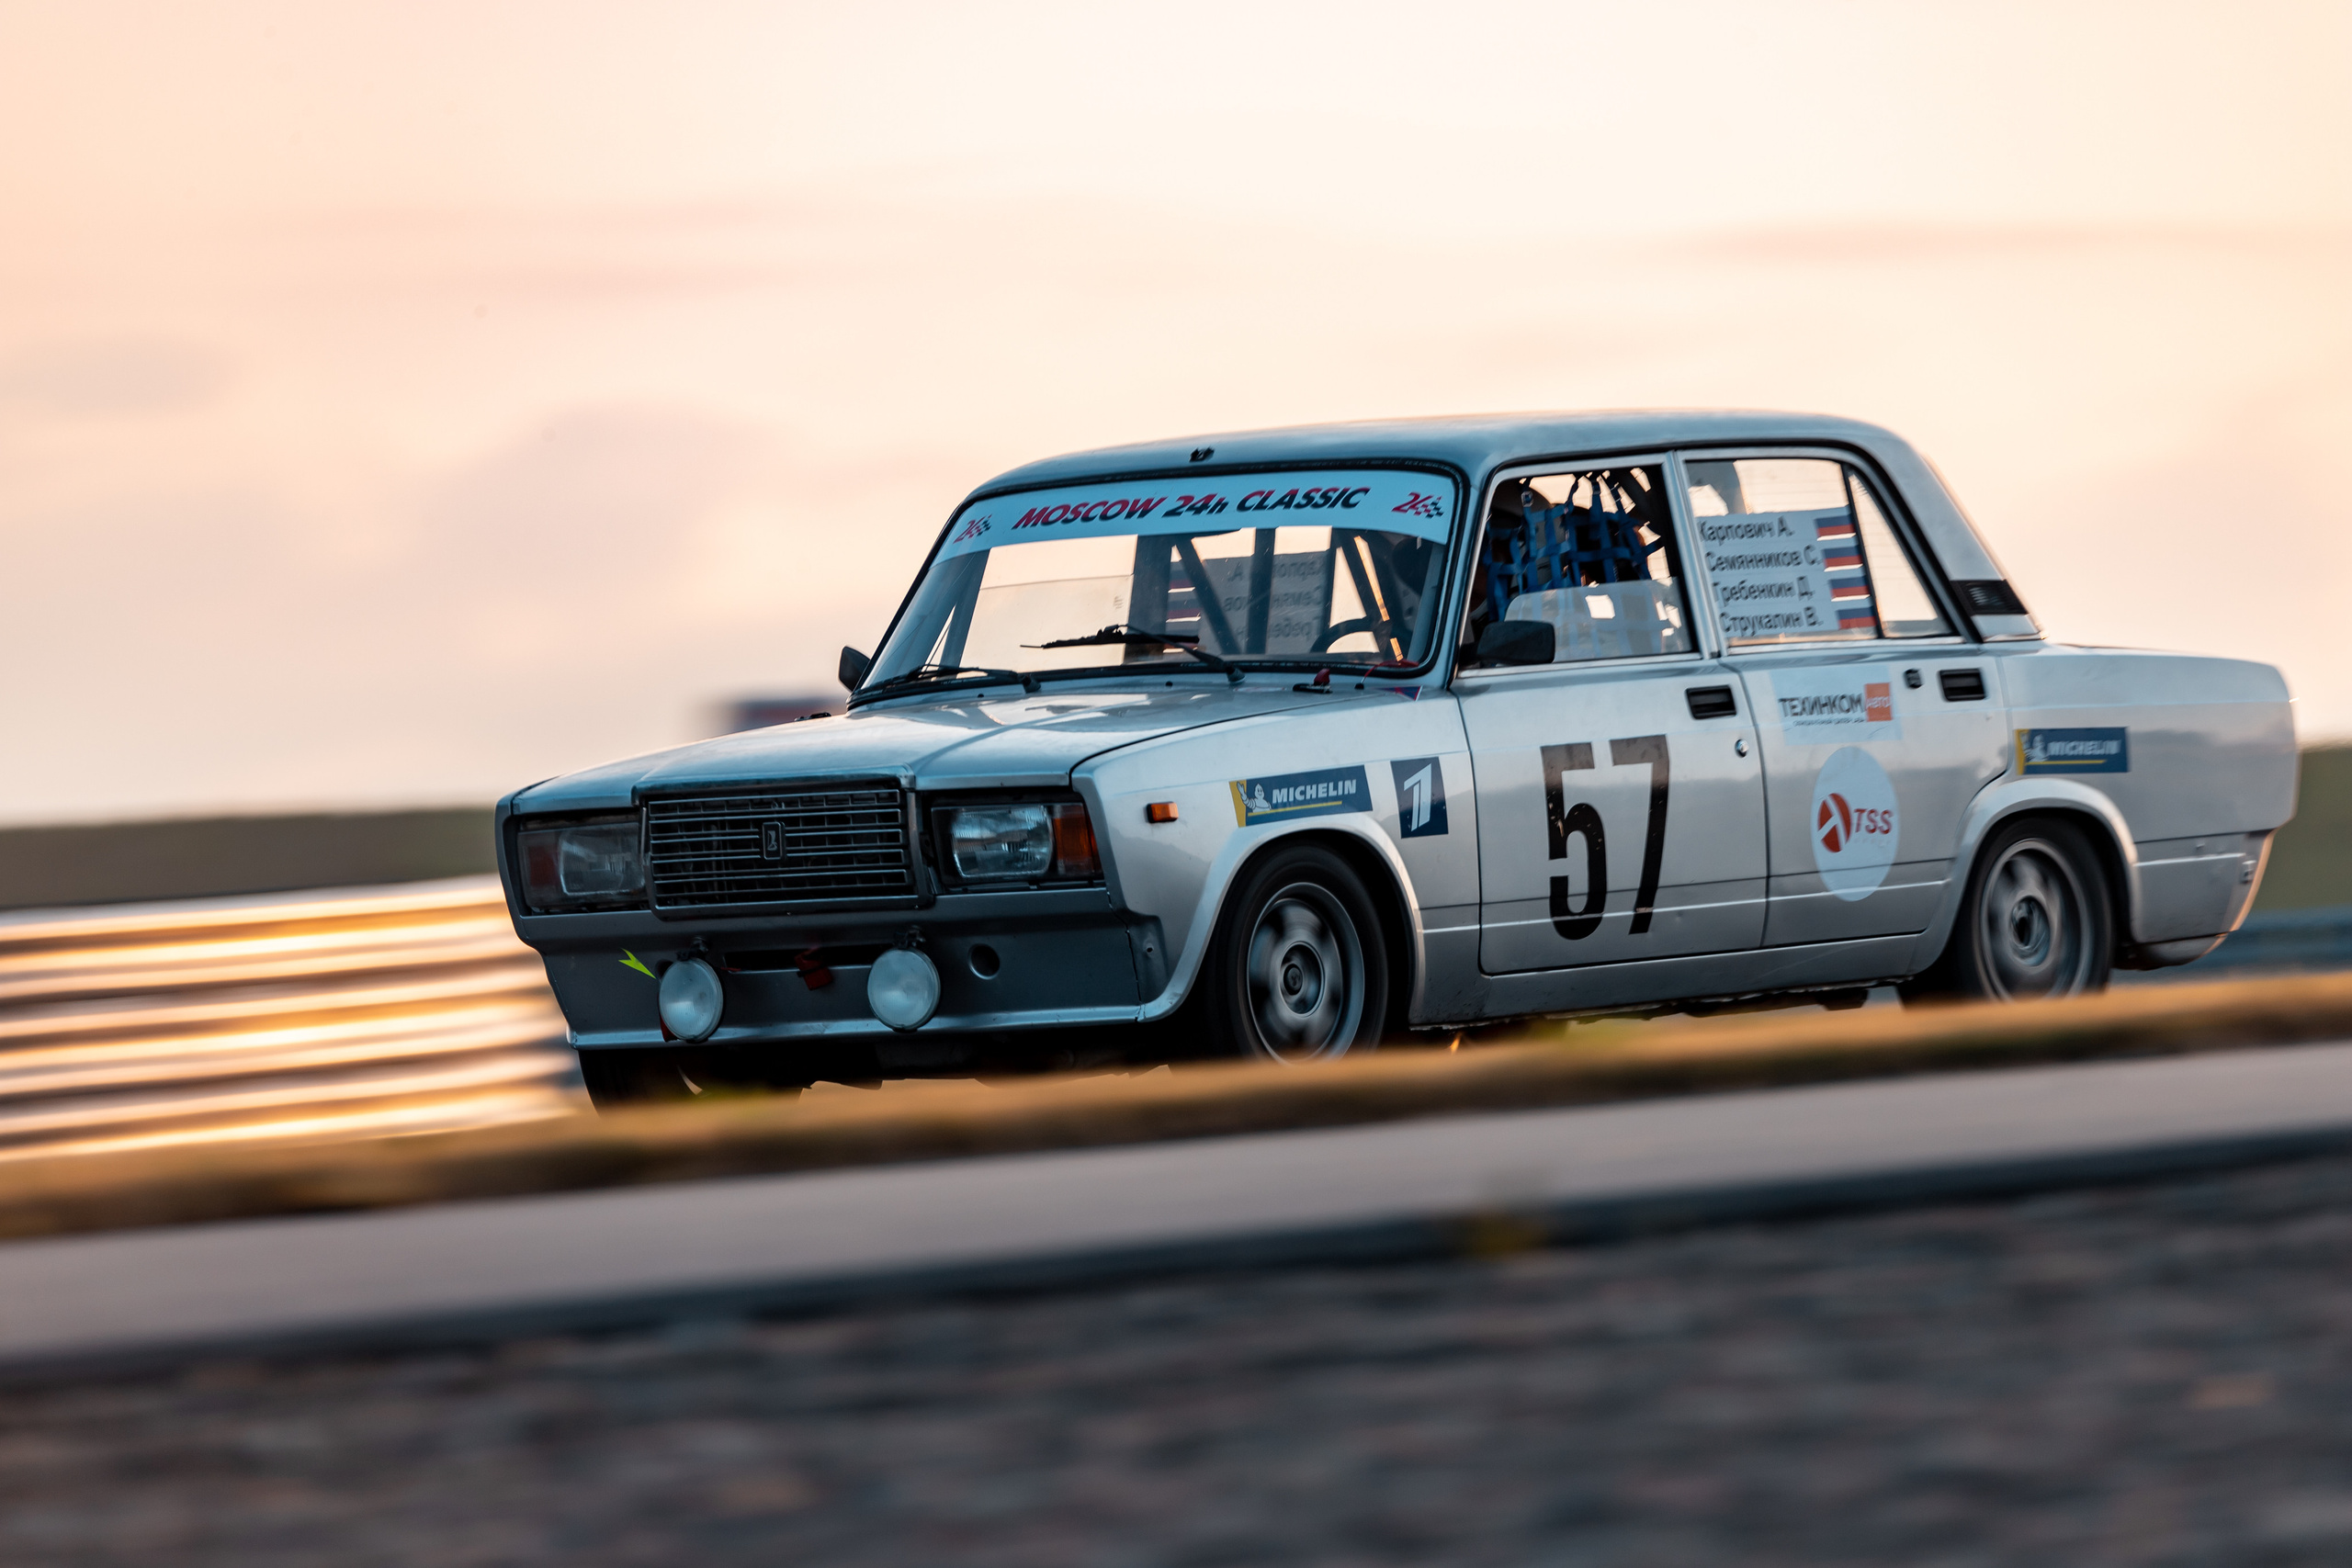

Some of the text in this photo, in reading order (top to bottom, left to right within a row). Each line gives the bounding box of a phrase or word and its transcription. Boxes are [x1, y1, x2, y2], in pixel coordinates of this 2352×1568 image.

[1011, 487, 1371, 530] MOSCOW 24h CLASSIC
[1698, 520, 1775, 546] Карпович
[1719, 612, 1804, 637] Струкалин
[1778, 693, 1866, 717] ТЕХИНКОМ
[2047, 739, 2121, 756] MICHELIN
[1272, 779, 1357, 804] MICHELIN
[1854, 808, 1894, 835] TSS
[1540, 734, 1669, 940] 57
